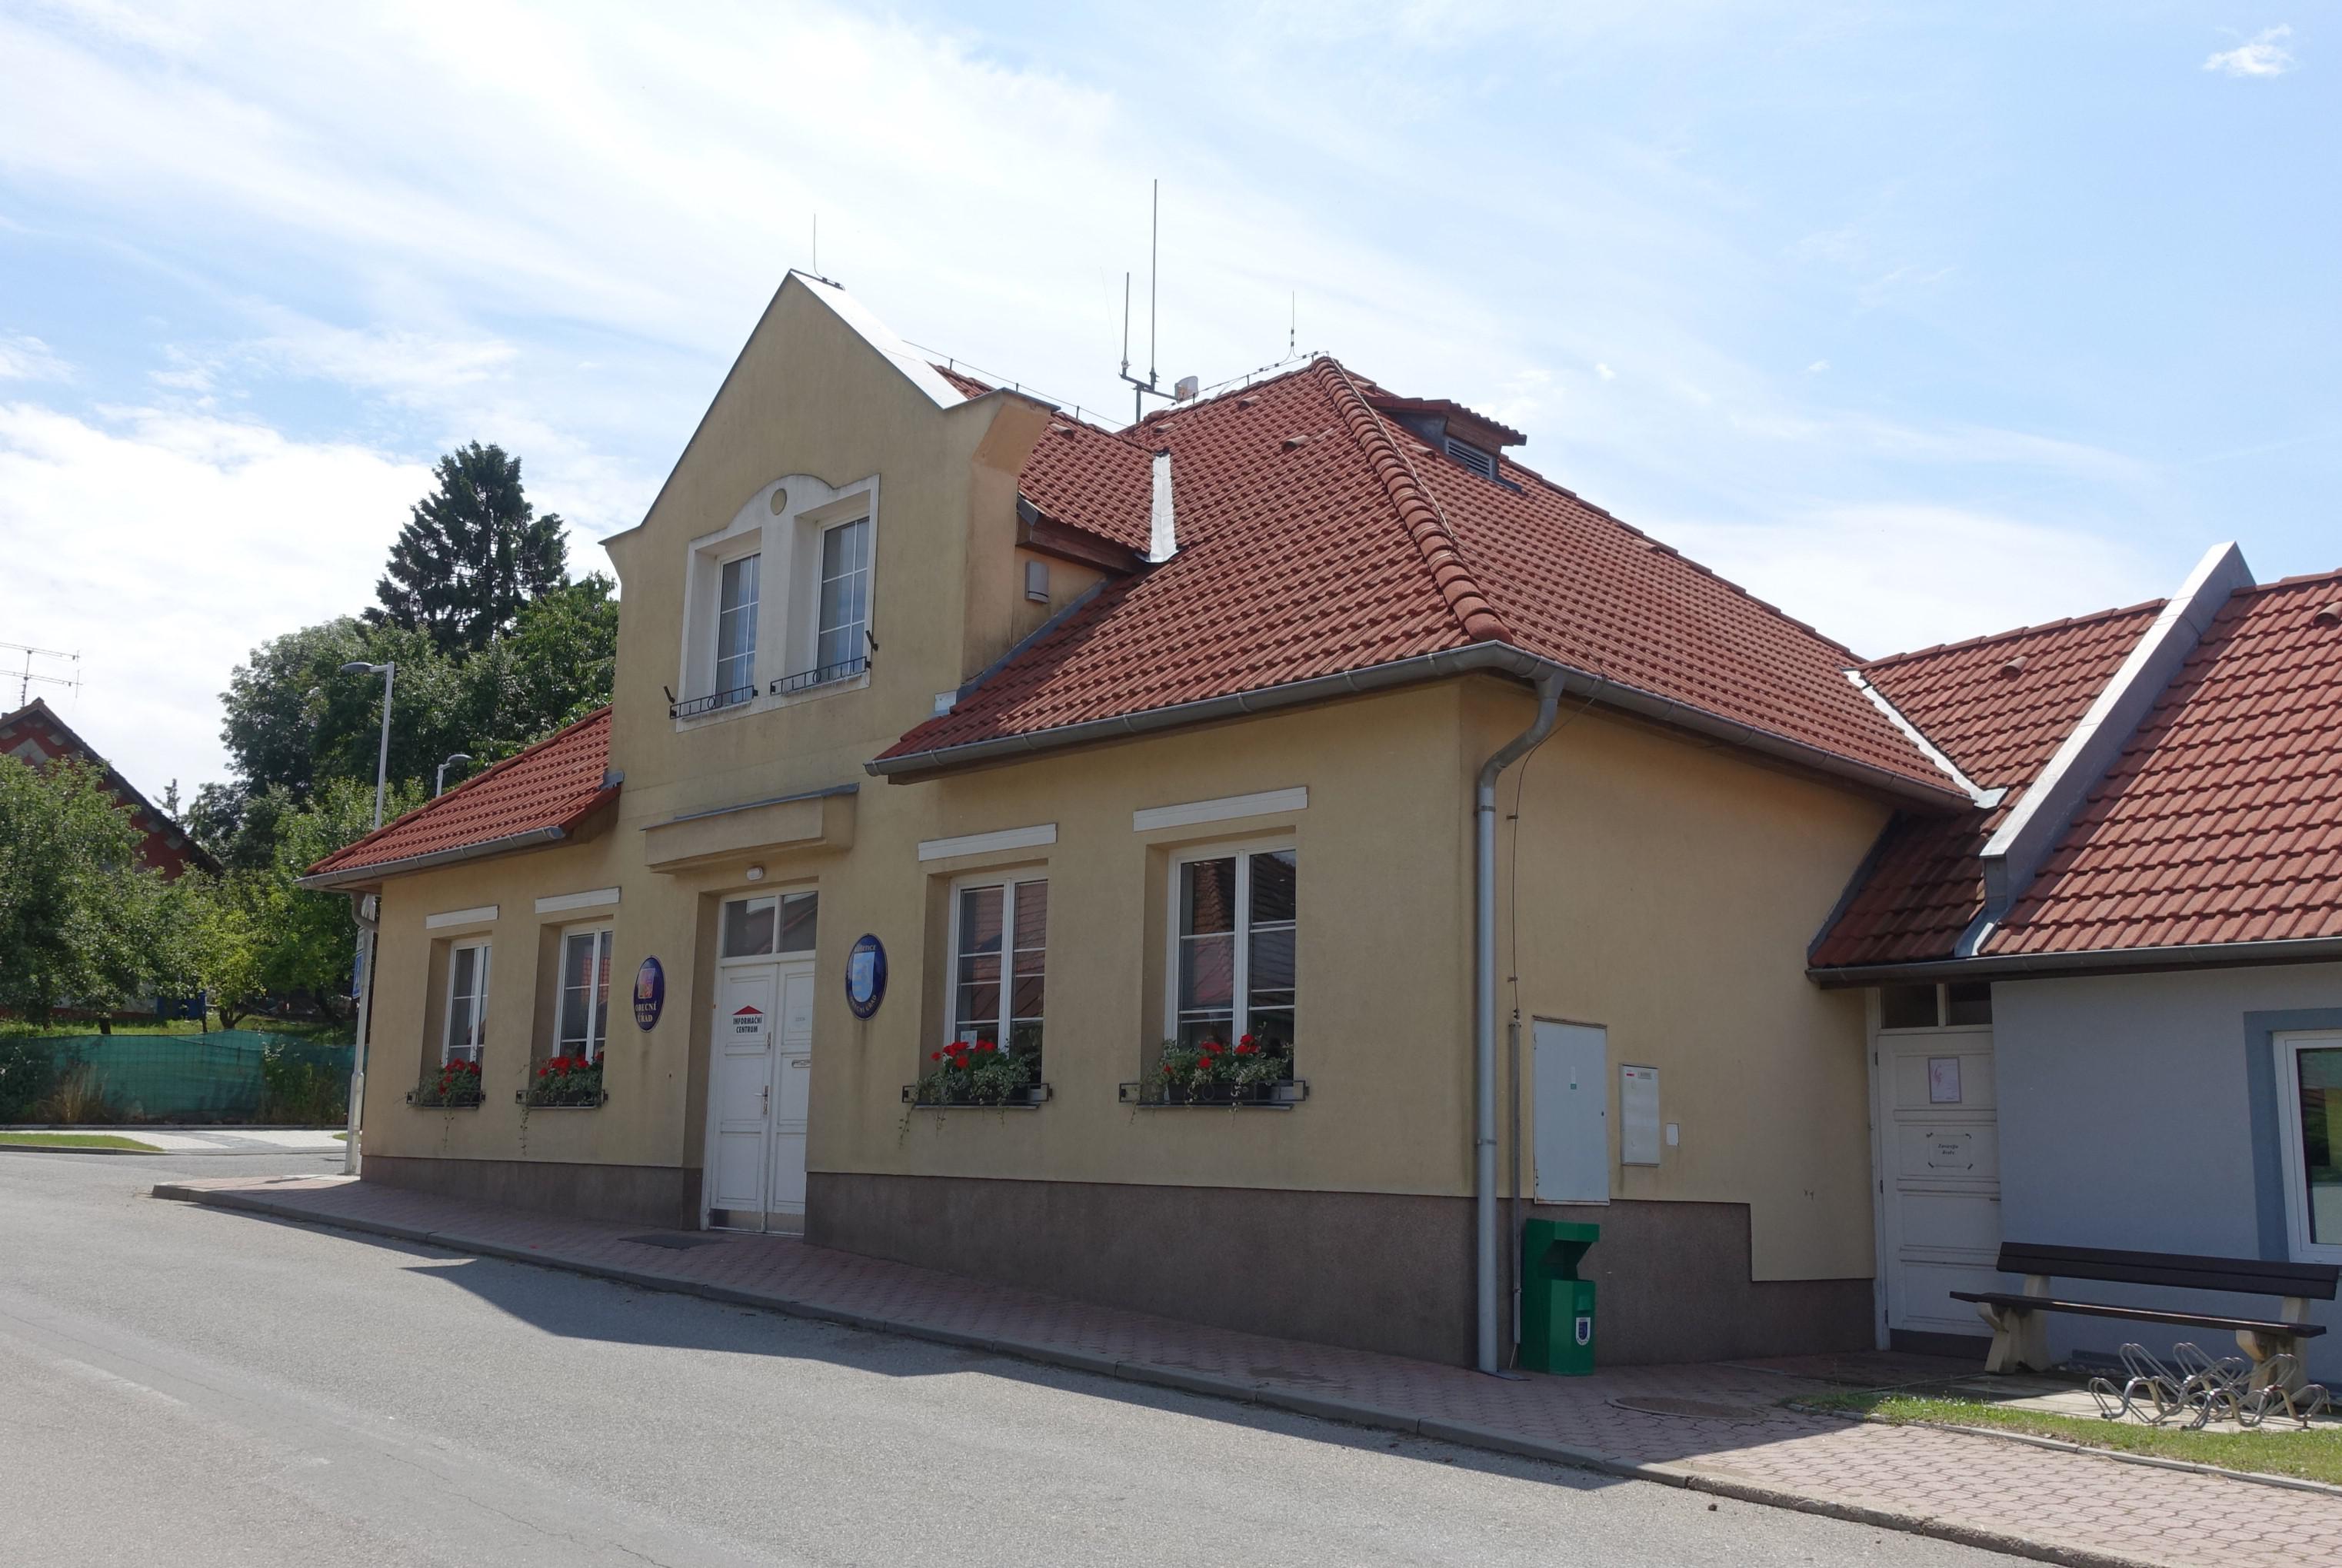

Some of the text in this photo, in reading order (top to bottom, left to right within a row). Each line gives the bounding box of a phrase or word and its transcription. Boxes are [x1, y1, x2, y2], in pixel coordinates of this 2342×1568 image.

[635, 1001, 656, 1011] OBECNÍ
[638, 1013, 652, 1022] ÚŘAD
[734, 1016, 762, 1025] INFORMAČNÍ
[736, 1025, 758, 1034] CENTRUM
